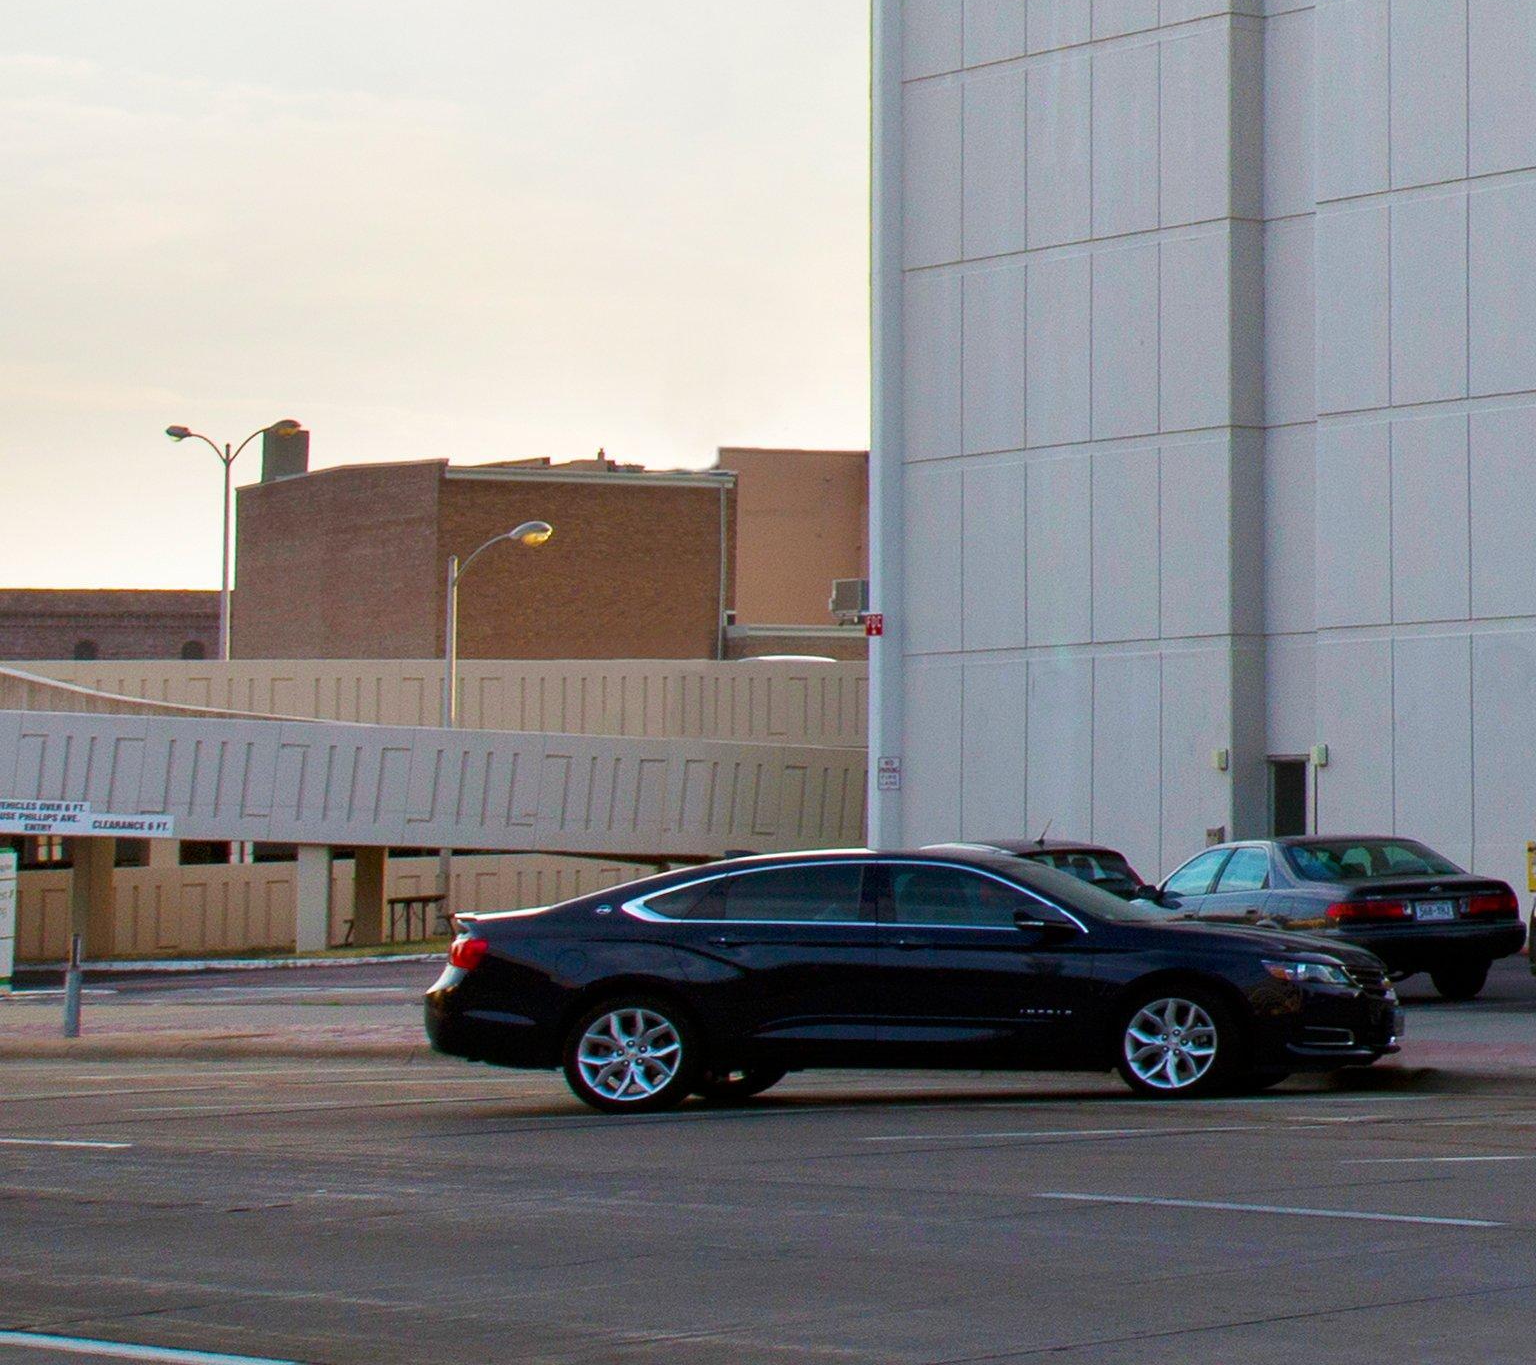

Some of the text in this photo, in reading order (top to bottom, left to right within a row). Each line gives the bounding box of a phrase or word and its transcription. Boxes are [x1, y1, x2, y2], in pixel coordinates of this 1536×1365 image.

[39, 802, 62, 811] OVER
[18, 812, 58, 822] PHILLIPS
[24, 823, 53, 832] ENTRY
[92, 820, 145, 831] CLEARANCE
